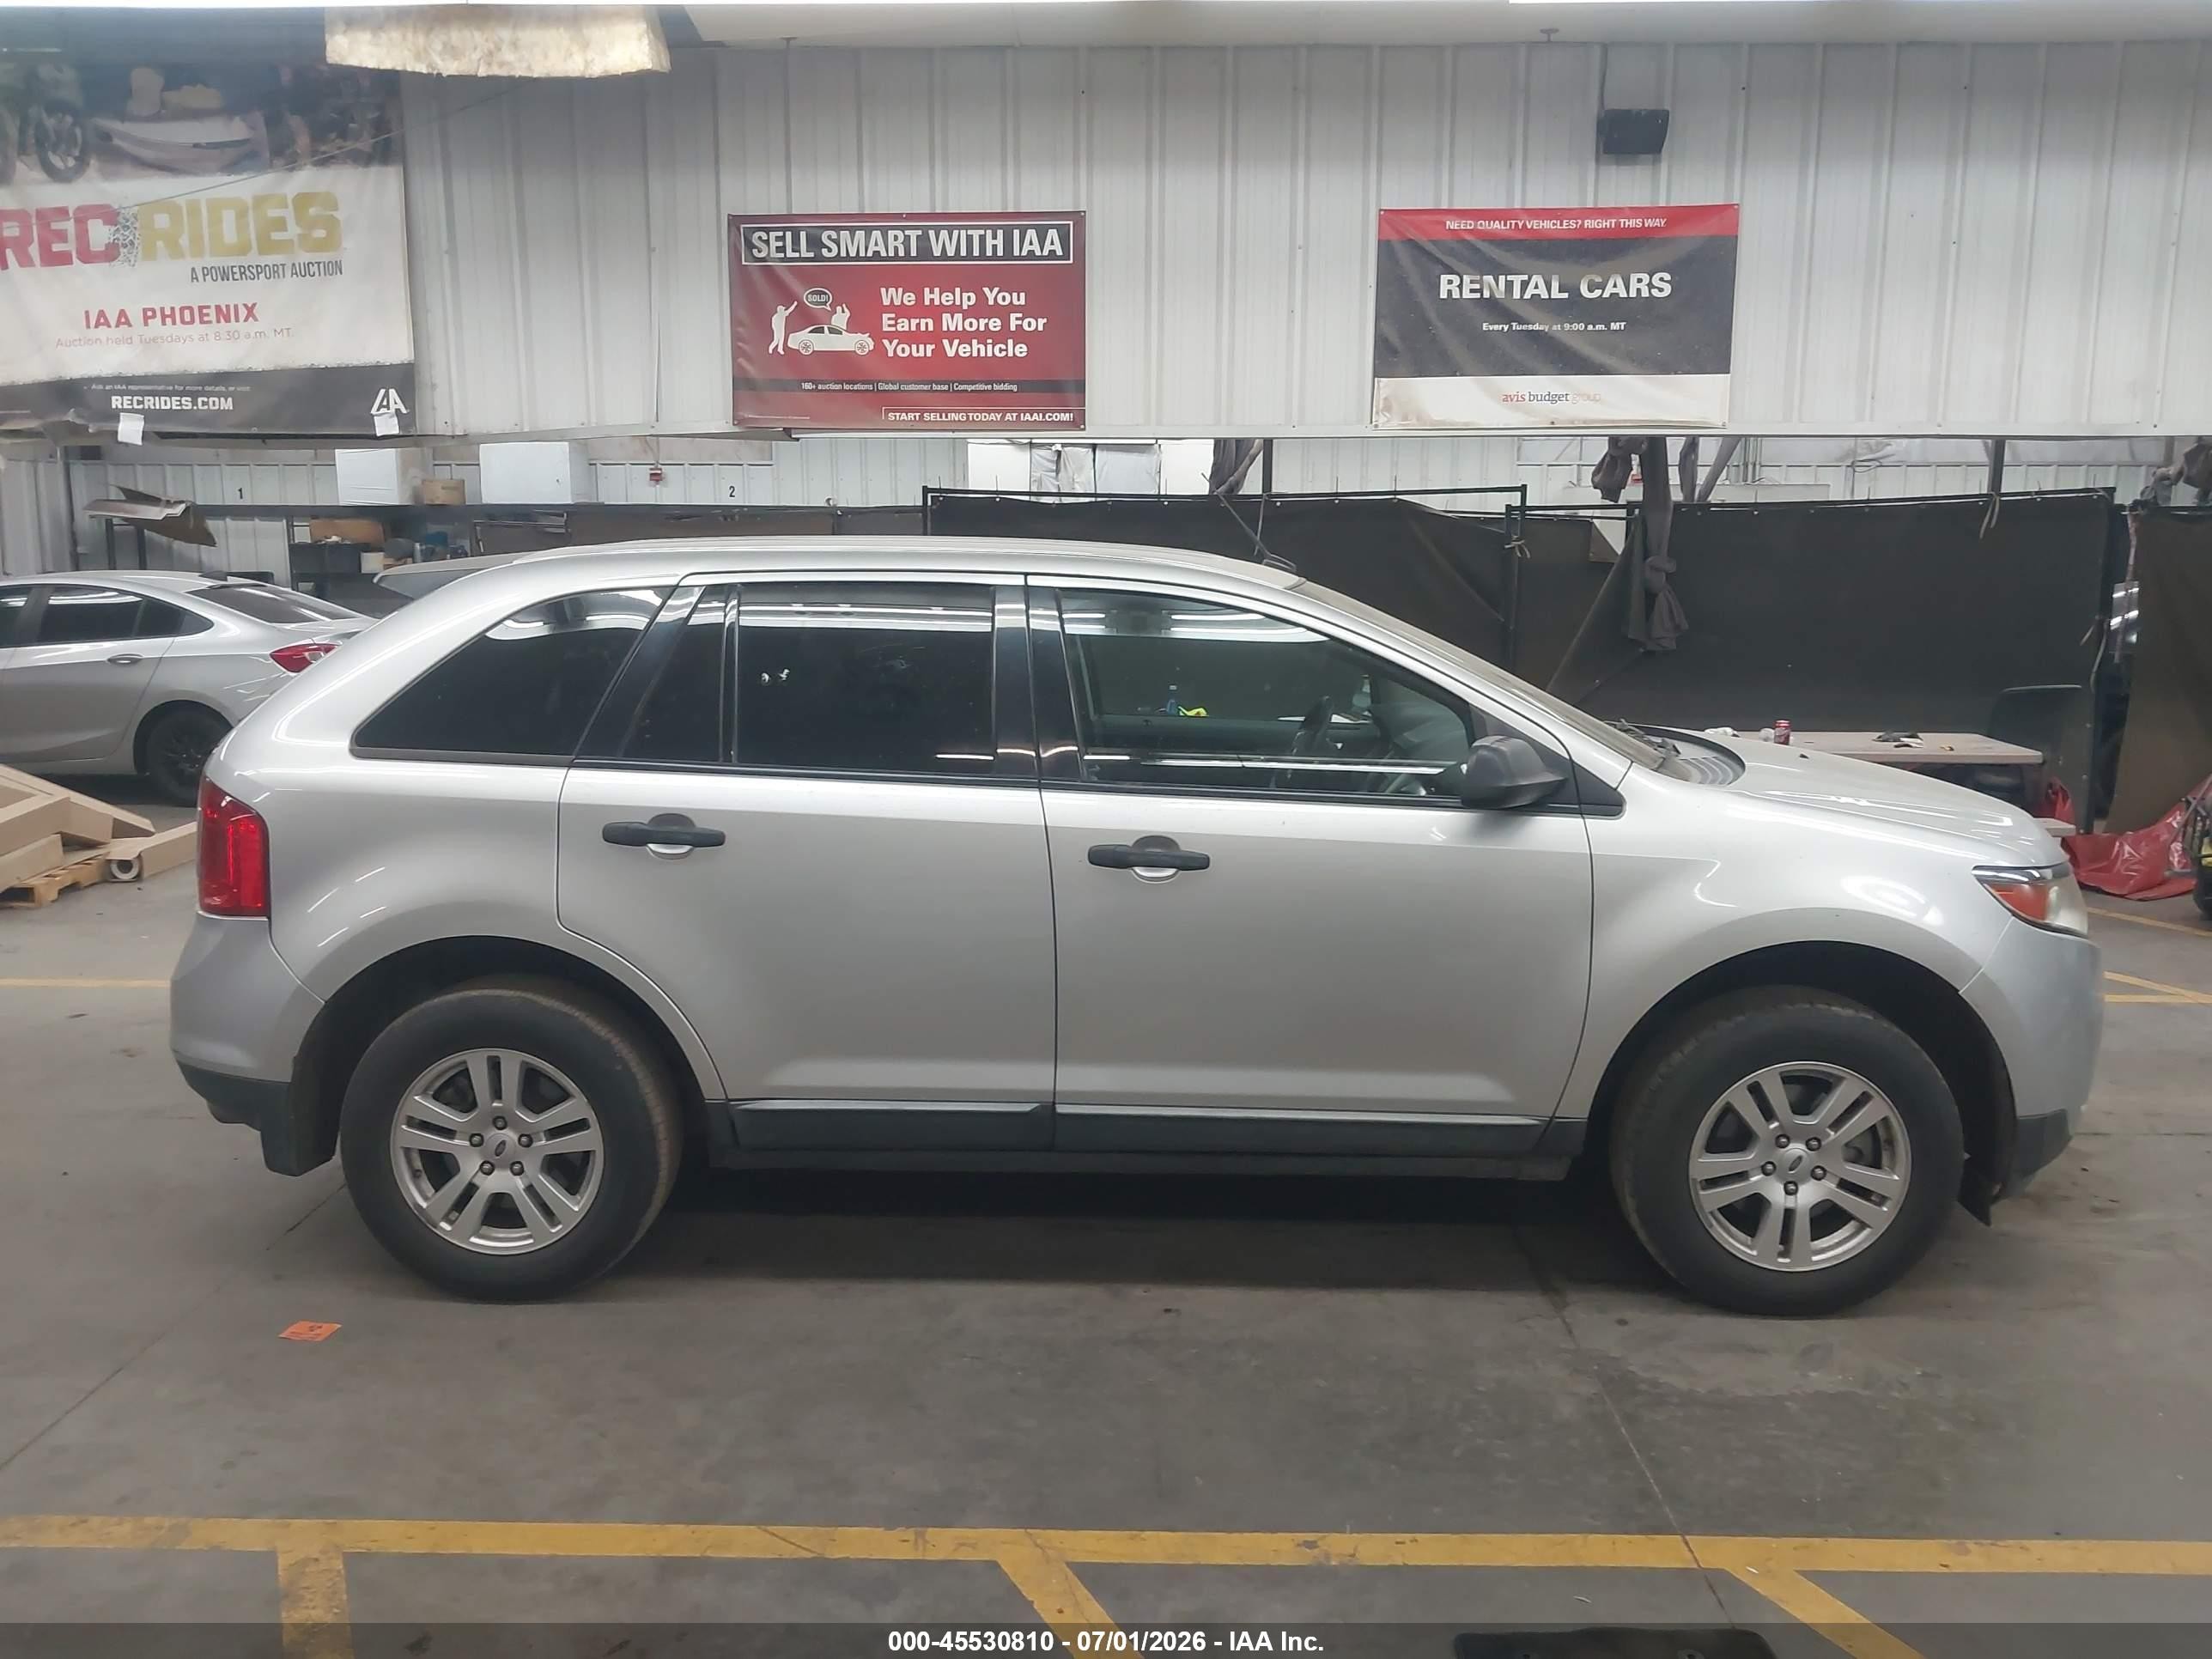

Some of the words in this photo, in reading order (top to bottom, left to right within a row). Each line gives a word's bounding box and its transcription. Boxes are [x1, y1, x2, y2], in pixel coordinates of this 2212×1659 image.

[0, 204, 121, 270] REC
[137, 191, 342, 262] RIDES
[1446, 220, 1474, 230] NEED
[1476, 219, 1524, 229] QUALITY
[1526, 219, 1582, 229] VEHICLES?
[1584, 219, 1616, 228] RIGHT
[1620, 218, 1643, 228] THIS
[751, 231, 815, 258] SELL
[821, 229, 922, 257] SMART
[928, 229, 1004, 257] WITH
[1013, 228, 1063, 256] IAA
[191, 267, 200, 283] A
[203, 263, 287, 282] POWERSPORT
[290, 259, 343, 277] AUCTION
[1439, 274, 1569, 299] RENTAL
[1579, 271, 1673, 298] CARS
[807, 294, 829, 302] SOLD!
[880, 287, 916, 306] We
[923, 287, 976, 310] Help
[982, 287, 1026, 306] You
[84, 308, 133, 329] IAA
[142, 302, 259, 327] PHOENIX
[882, 313, 933, 331] Earn
[942, 313, 1002, 331] More
[1009, 313, 1047, 331] For
[1482, 323, 1509, 332] Every
[1511, 323, 1549, 332] Tuesday
[1563, 323, 1585, 331] 9:00
[1610, 322, 1626, 331] MT
[56, 337, 102, 348] Auction
[106, 336, 133, 345] held
[137, 333, 194, 344] Tuesdays
[198, 332, 210, 342] at
[214, 330, 240, 341] 830
[882, 338, 935, 357] Your
[942, 338, 1028, 357] Vehicle
[953, 383, 992, 392] Competitive
[994, 383, 1018, 392] bidding
[111, 395, 234, 410] RECRIDES.COM
[1503, 392, 1526, 403] avis
[1528, 392, 1571, 404] budget
[888, 412, 921, 421] START
[923, 412, 967, 421] SELLING
[968, 412, 1003, 421] TODAY
[1005, 412, 1018, 421] AT
[1020, 412, 1073, 421] IAAI.COM!
[237, 487, 244, 500] 1
[728, 485, 736, 498] 2
